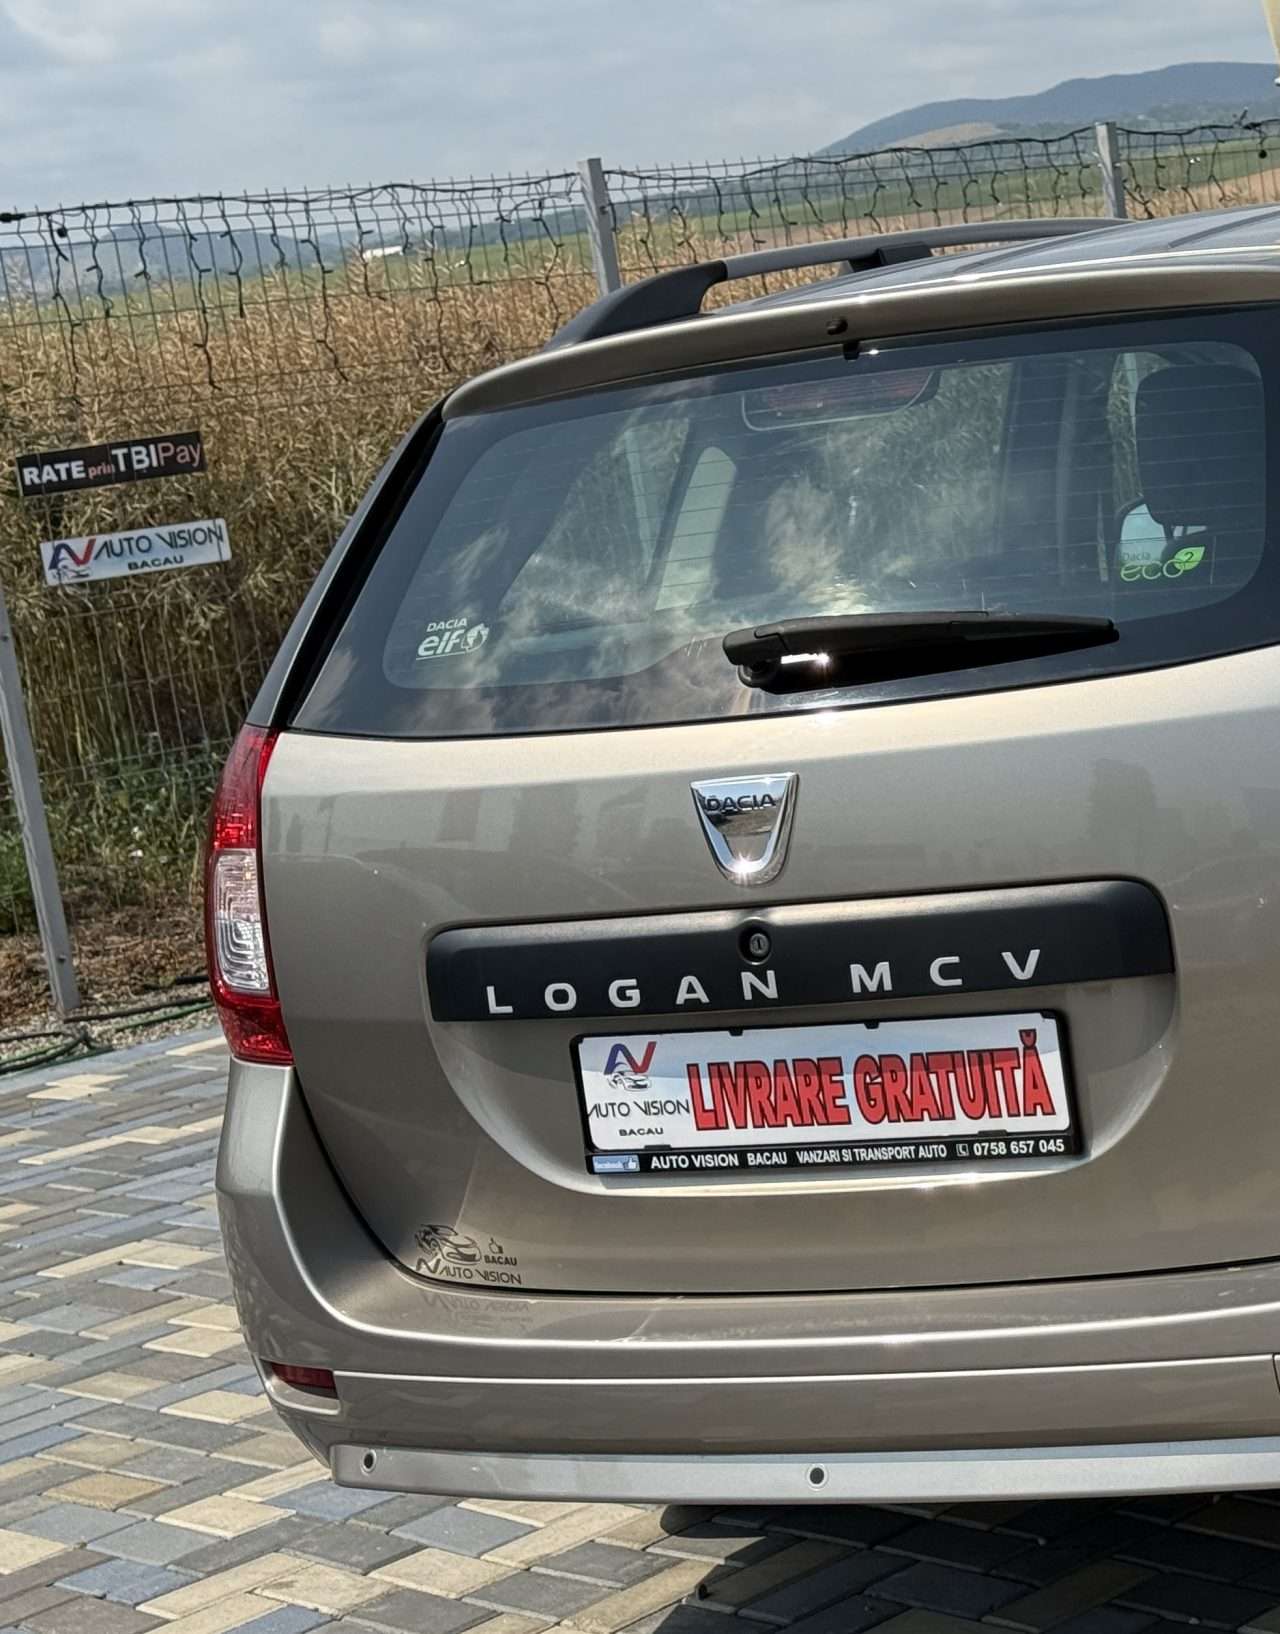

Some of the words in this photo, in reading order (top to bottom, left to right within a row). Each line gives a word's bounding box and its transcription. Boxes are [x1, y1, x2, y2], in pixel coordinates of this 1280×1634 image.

[22, 460, 86, 485] RATE
[94, 535, 153, 560] AUTO
[155, 525, 224, 550] VISION
[127, 555, 185, 571] BACAU
[426, 618, 468, 632] DACIA
[705, 793, 777, 811] DACIA
[486, 970, 779, 1015] LOGAN
[850, 949, 1041, 994] MCV
[687, 1056, 852, 1132] LIVRARE
[853, 1029, 1057, 1125] GRATUITĂ
[588, 1102, 630, 1119] AUTO
[633, 1099, 690, 1117] VISION
[619, 1127, 664, 1137] BACAU
[651, 1154, 690, 1169] AUTO
[692, 1152, 740, 1168] VISION
[747, 1150, 788, 1166] BACAU
[796, 1149, 841, 1164] VANZARI
[842, 1148, 853, 1162] SI
[853, 1145, 916, 1161] TRANSPORT
[918, 1144, 948, 1159] AUTO
[973, 1142, 1007, 1156] 0758
[1010, 1140, 1034, 1154] 657
[1039, 1138, 1065, 1153] 045
[484, 1255, 518, 1266] BACAU
[439, 1266, 473, 1279] AUTO
[475, 1268, 522, 1285] VISION
